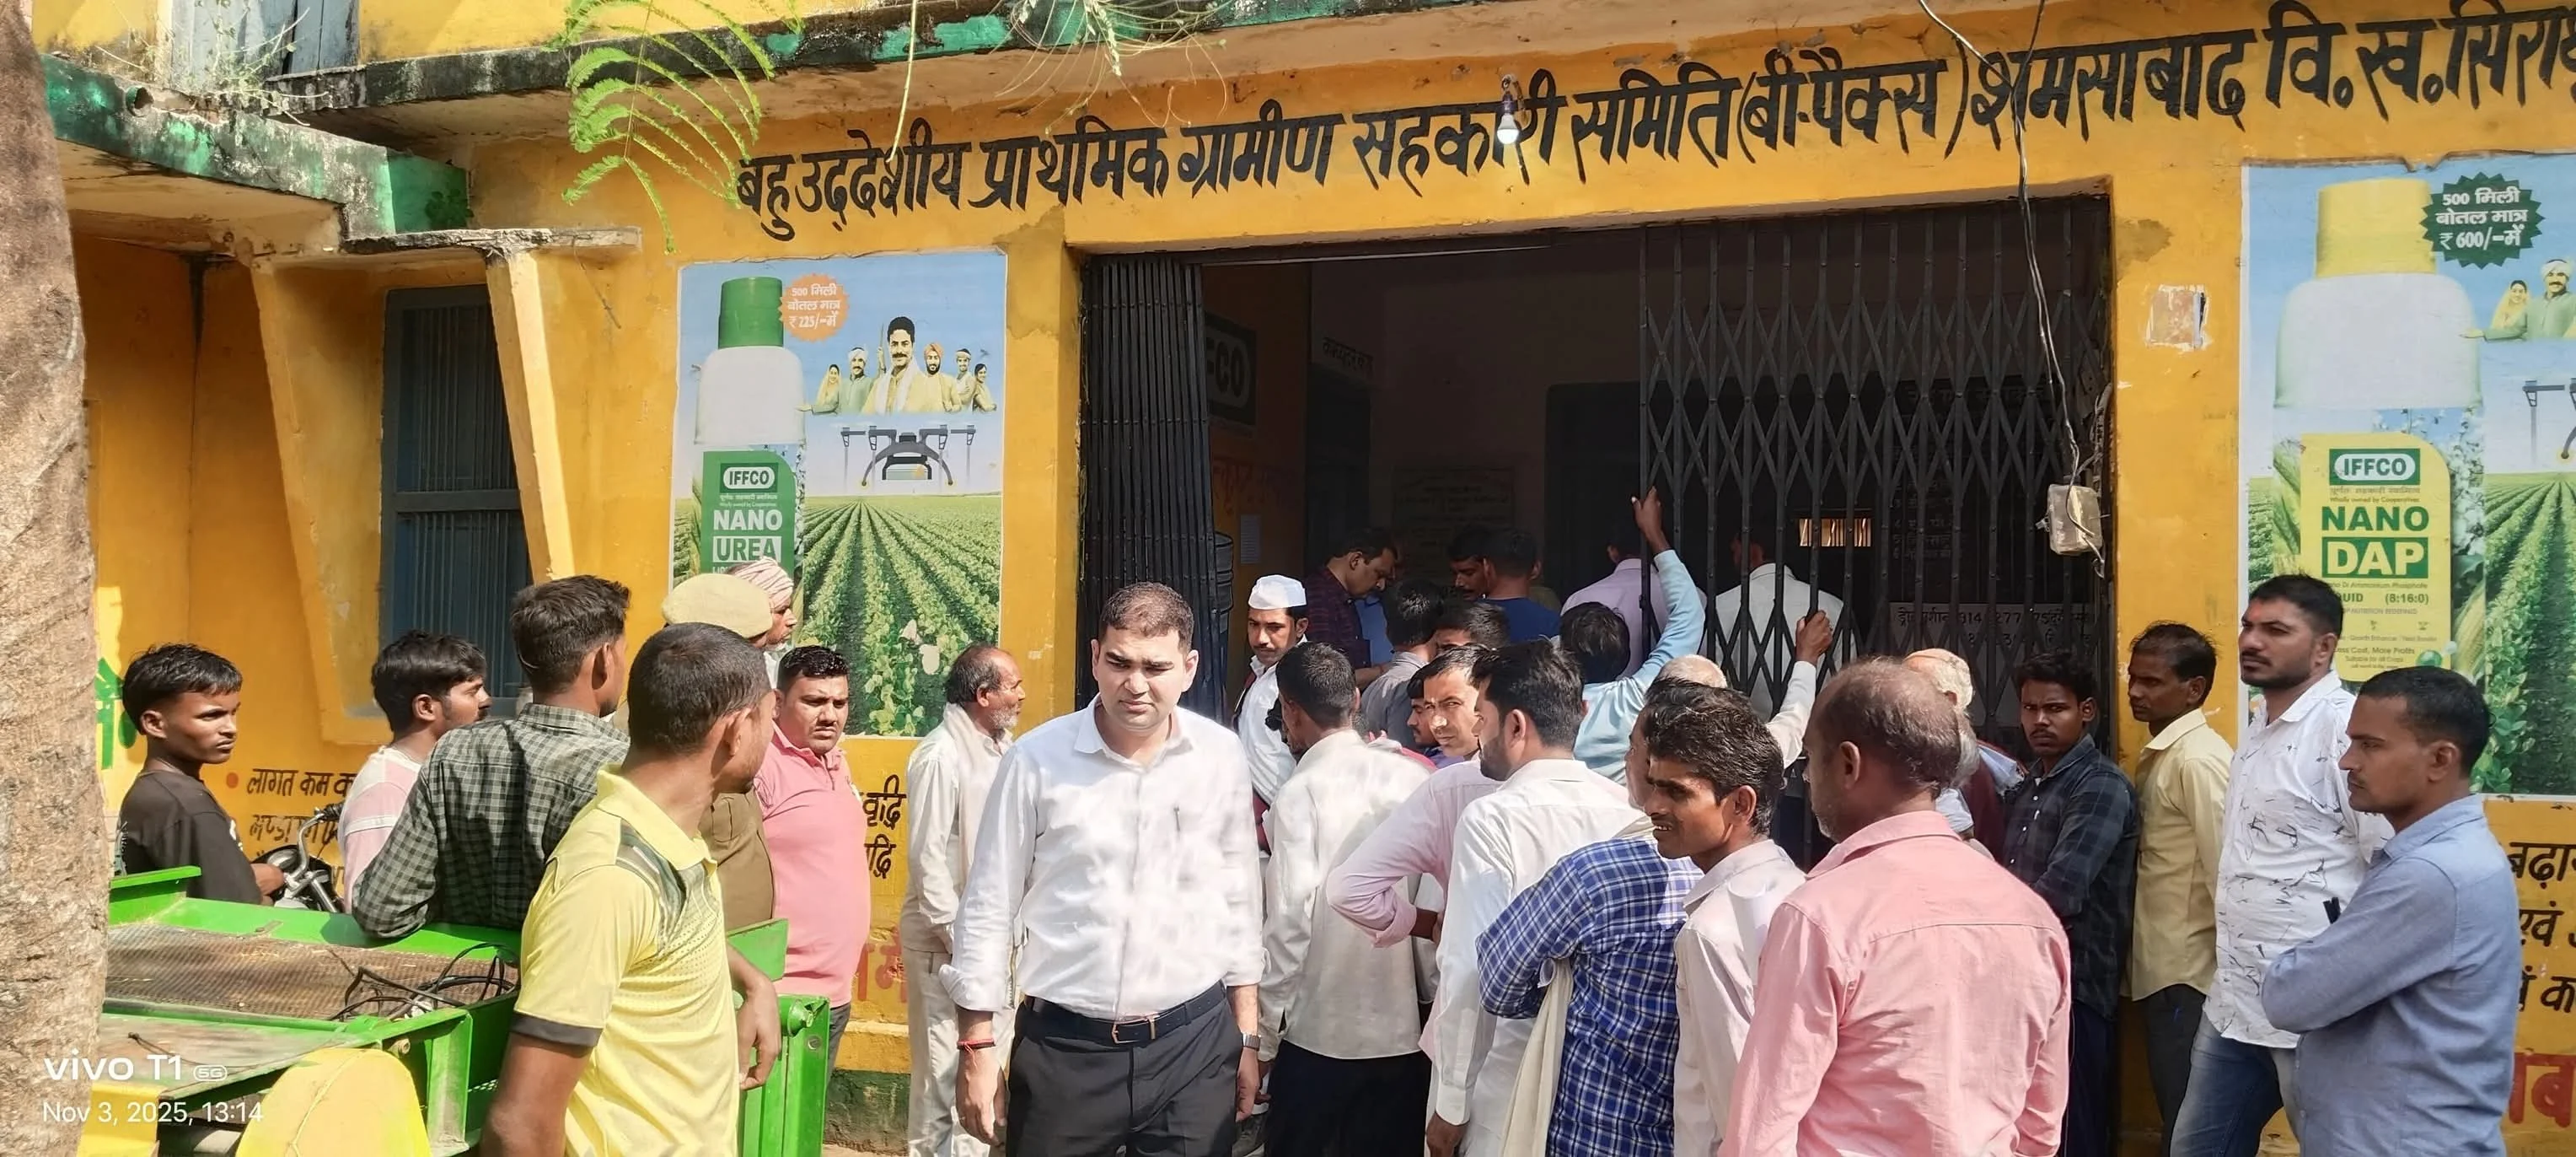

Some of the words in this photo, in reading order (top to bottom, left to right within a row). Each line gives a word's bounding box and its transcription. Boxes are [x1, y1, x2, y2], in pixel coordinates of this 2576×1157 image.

[968, 116, 1168, 212] प्राथमिक
[1178, 99, 1346, 199] ग्रामीण
[1353, 67, 1569, 198] सहकारी
[1571, 62, 1743, 185] समिति
[2442, 192, 2470, 206] 500
[2475, 186, 2520, 204] मिली
[2434, 207, 2488, 225] बोतल
[2491, 209, 2529, 223] मात्र
[792, 287, 808, 297] 500
[810, 283, 837, 296] मिली
[787, 299, 818, 311] बोतल
[2343, 458, 2407, 476] IFFCO
[729, 470, 770, 487] IFFCO
[713, 509, 783, 531] NANO
[2321, 506, 2429, 531] NANO
[716, 537, 777, 562] UREA
[2326, 541, 2425, 575] DAP
[247, 768, 299, 797] लागत
[299, 772, 335, 797] कम
